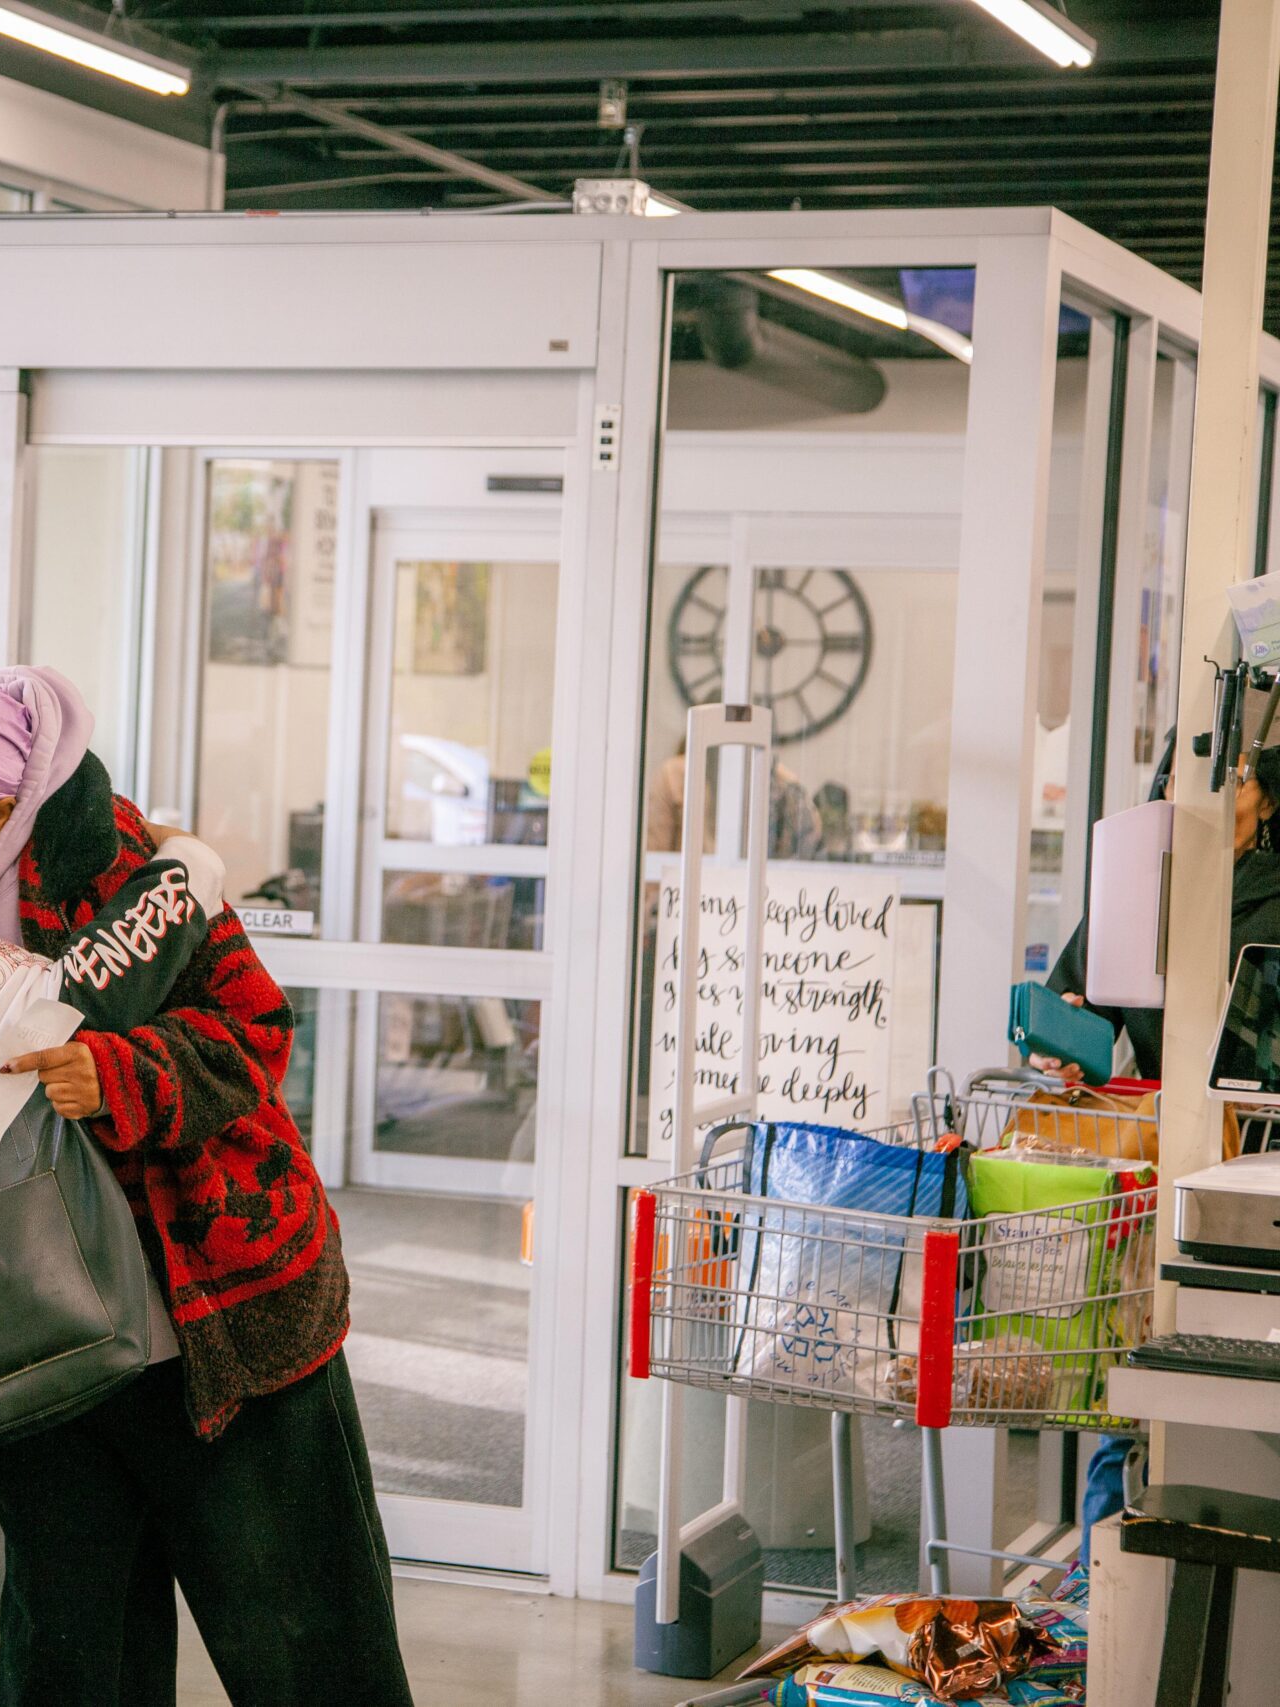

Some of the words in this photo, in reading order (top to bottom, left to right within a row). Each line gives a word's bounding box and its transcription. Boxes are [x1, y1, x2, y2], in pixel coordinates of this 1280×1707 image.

[63, 867, 195, 991] VENGER
[242, 911, 294, 929] CLEAR
[663, 886, 745, 936] Bing
[763, 886, 823, 943] eeply
[824, 886, 894, 938] loved
[720, 945, 875, 975] smeone
[663, 980, 724, 1012] ges
[655, 1022, 742, 1060] wile
[759, 1028, 866, 1083] oving
[782, 1066, 880, 1120] deeply
